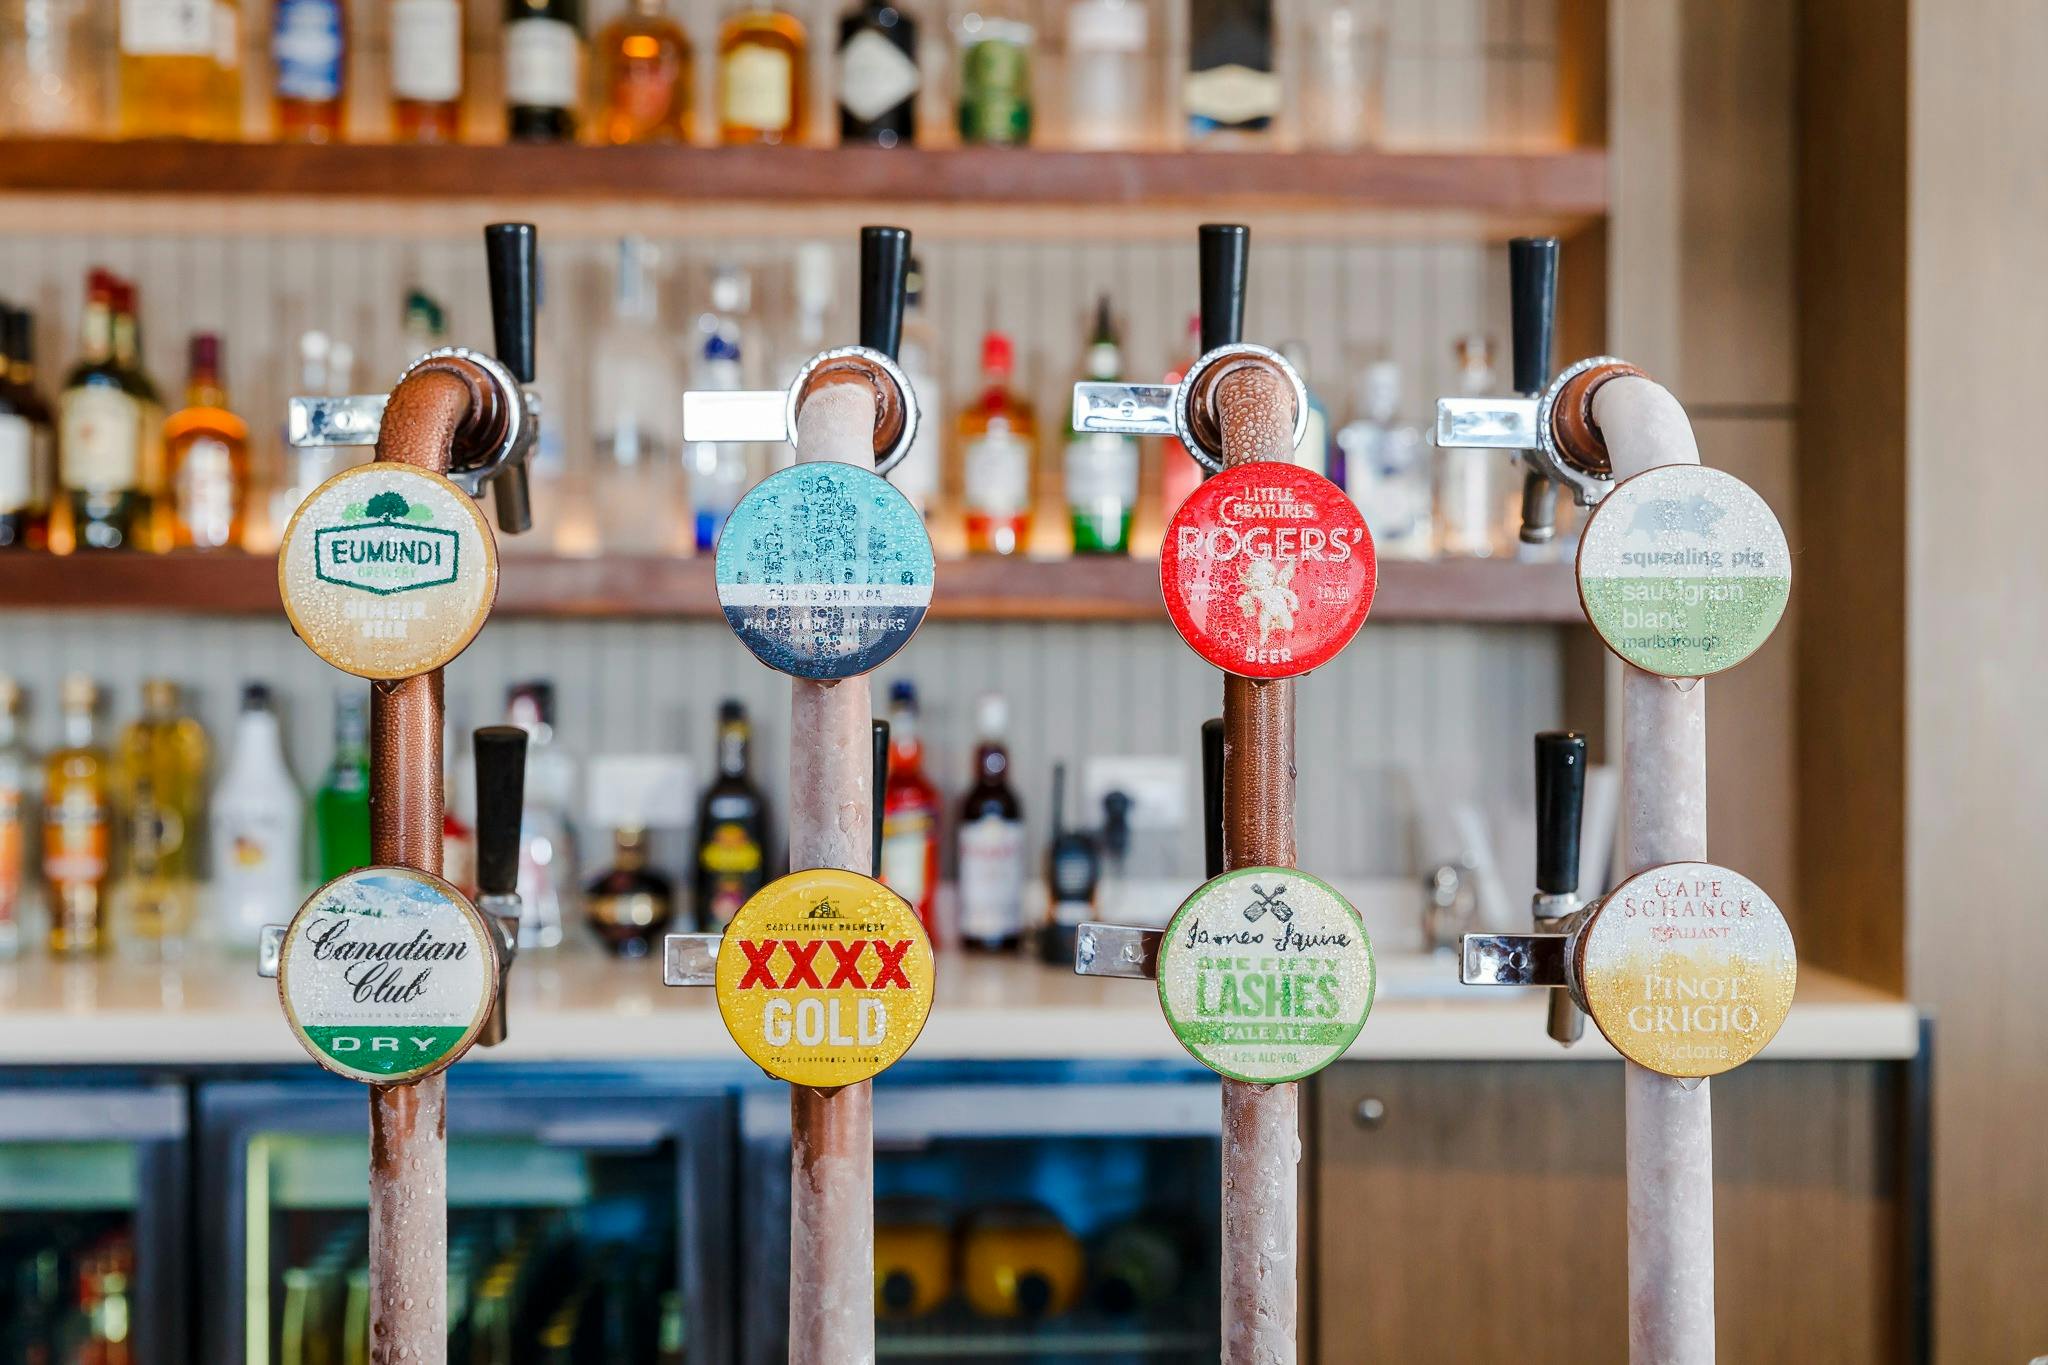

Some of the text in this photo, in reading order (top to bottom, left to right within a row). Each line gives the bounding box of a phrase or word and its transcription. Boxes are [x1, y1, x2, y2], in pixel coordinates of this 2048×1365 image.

[1244, 486, 1294, 502] LITTLE
[1219, 495, 1318, 526] CREATURES
[331, 540, 441, 566] EUMUNDI
[1622, 547, 1764, 568] squealing pig
[769, 588, 883, 601] THIS IS OUR XPA
[1244, 648, 1294, 664] BEER
[1622, 635, 1721, 652] marlborough
[1655, 878, 1723, 898] CAPE
[305, 913, 469, 961] Canadian
[1186, 917, 1351, 952] James Squire
[736, 939, 916, 990] XXXX
[1197, 957, 1340, 971] ONE FIFTY
[344, 961, 432, 1004] Club
[1644, 975, 1742, 1000] PINOT
[1196, 973, 1340, 1019] LASHES
[763, 997, 888, 1048] GOLD
[1627, 1004, 1758, 1034] GRIGIO
[332, 1036, 437, 1051] DRY
[1223, 1026, 1308, 1040] PALE ALE
